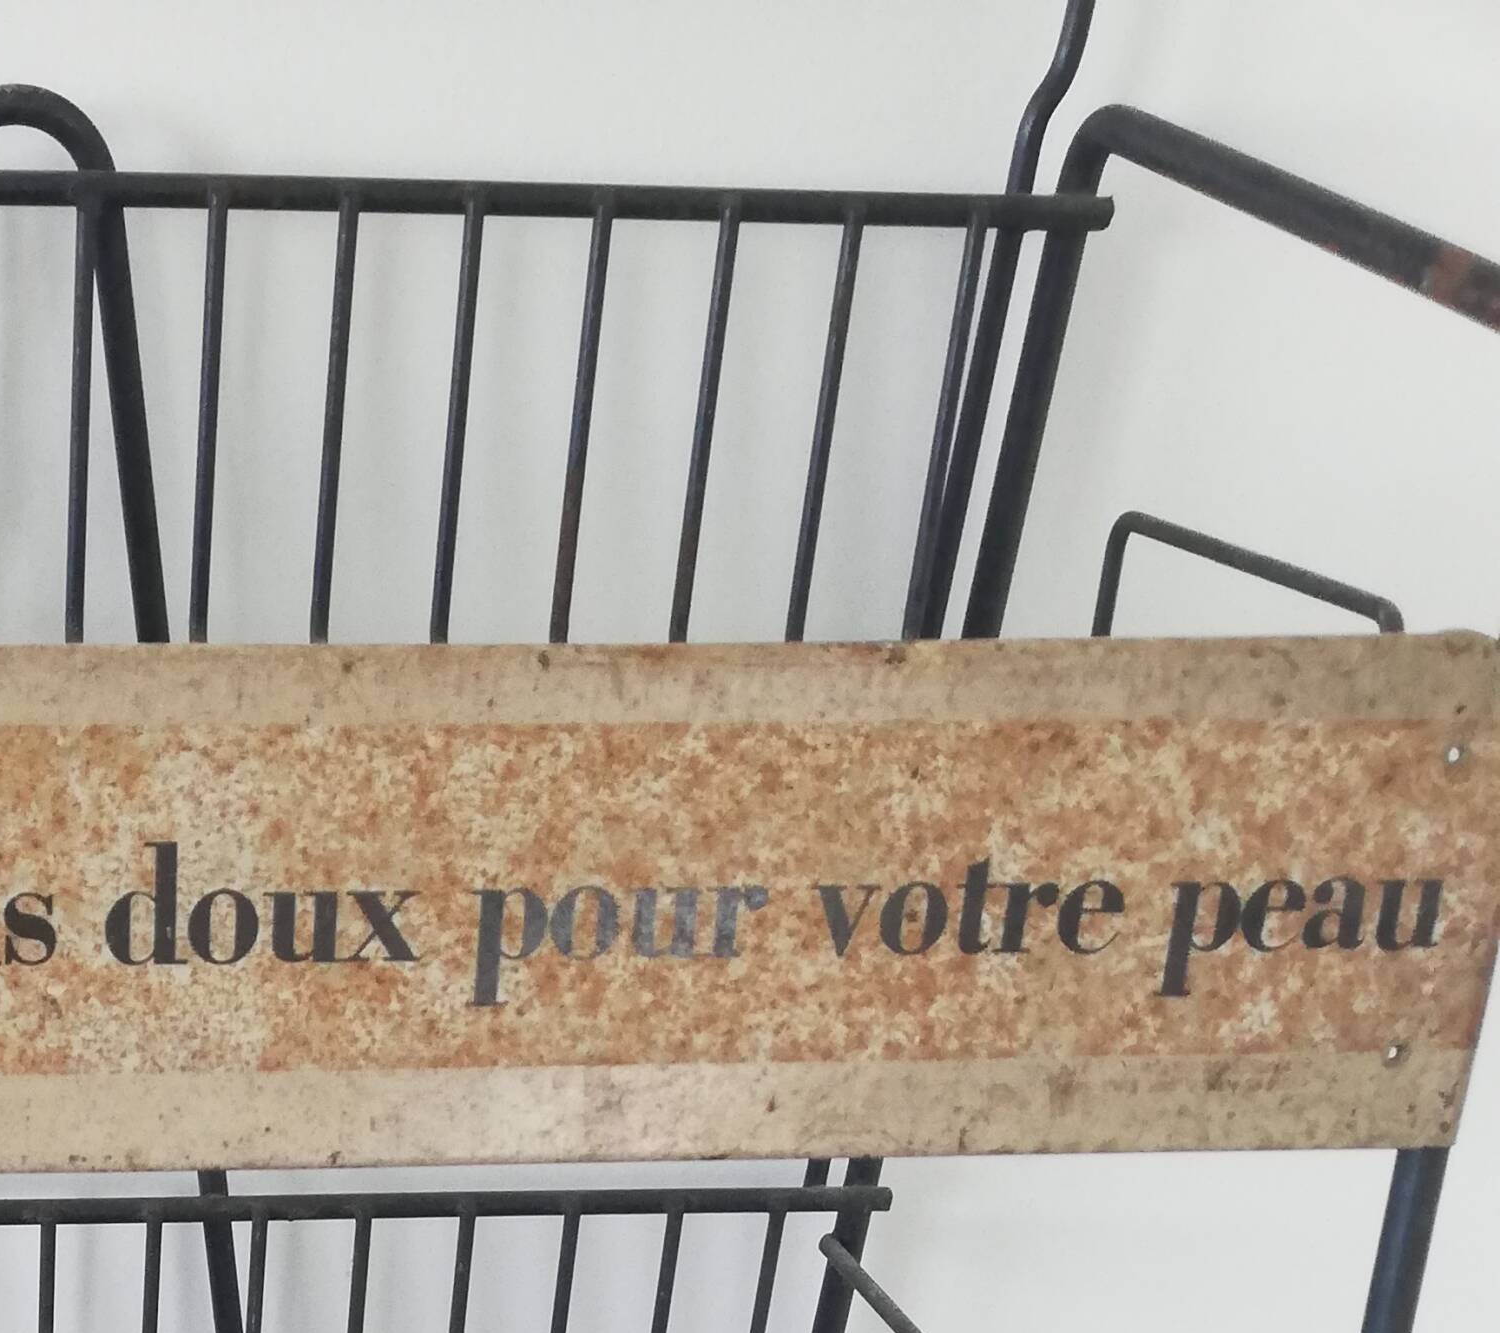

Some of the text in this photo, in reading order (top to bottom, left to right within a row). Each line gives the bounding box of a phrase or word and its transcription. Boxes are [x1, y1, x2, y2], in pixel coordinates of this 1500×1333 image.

[105, 841, 421, 967] doux
[466, 884, 769, 1007] pour
[811, 857, 1125, 959] votre
[1154, 875, 1444, 997] peau
